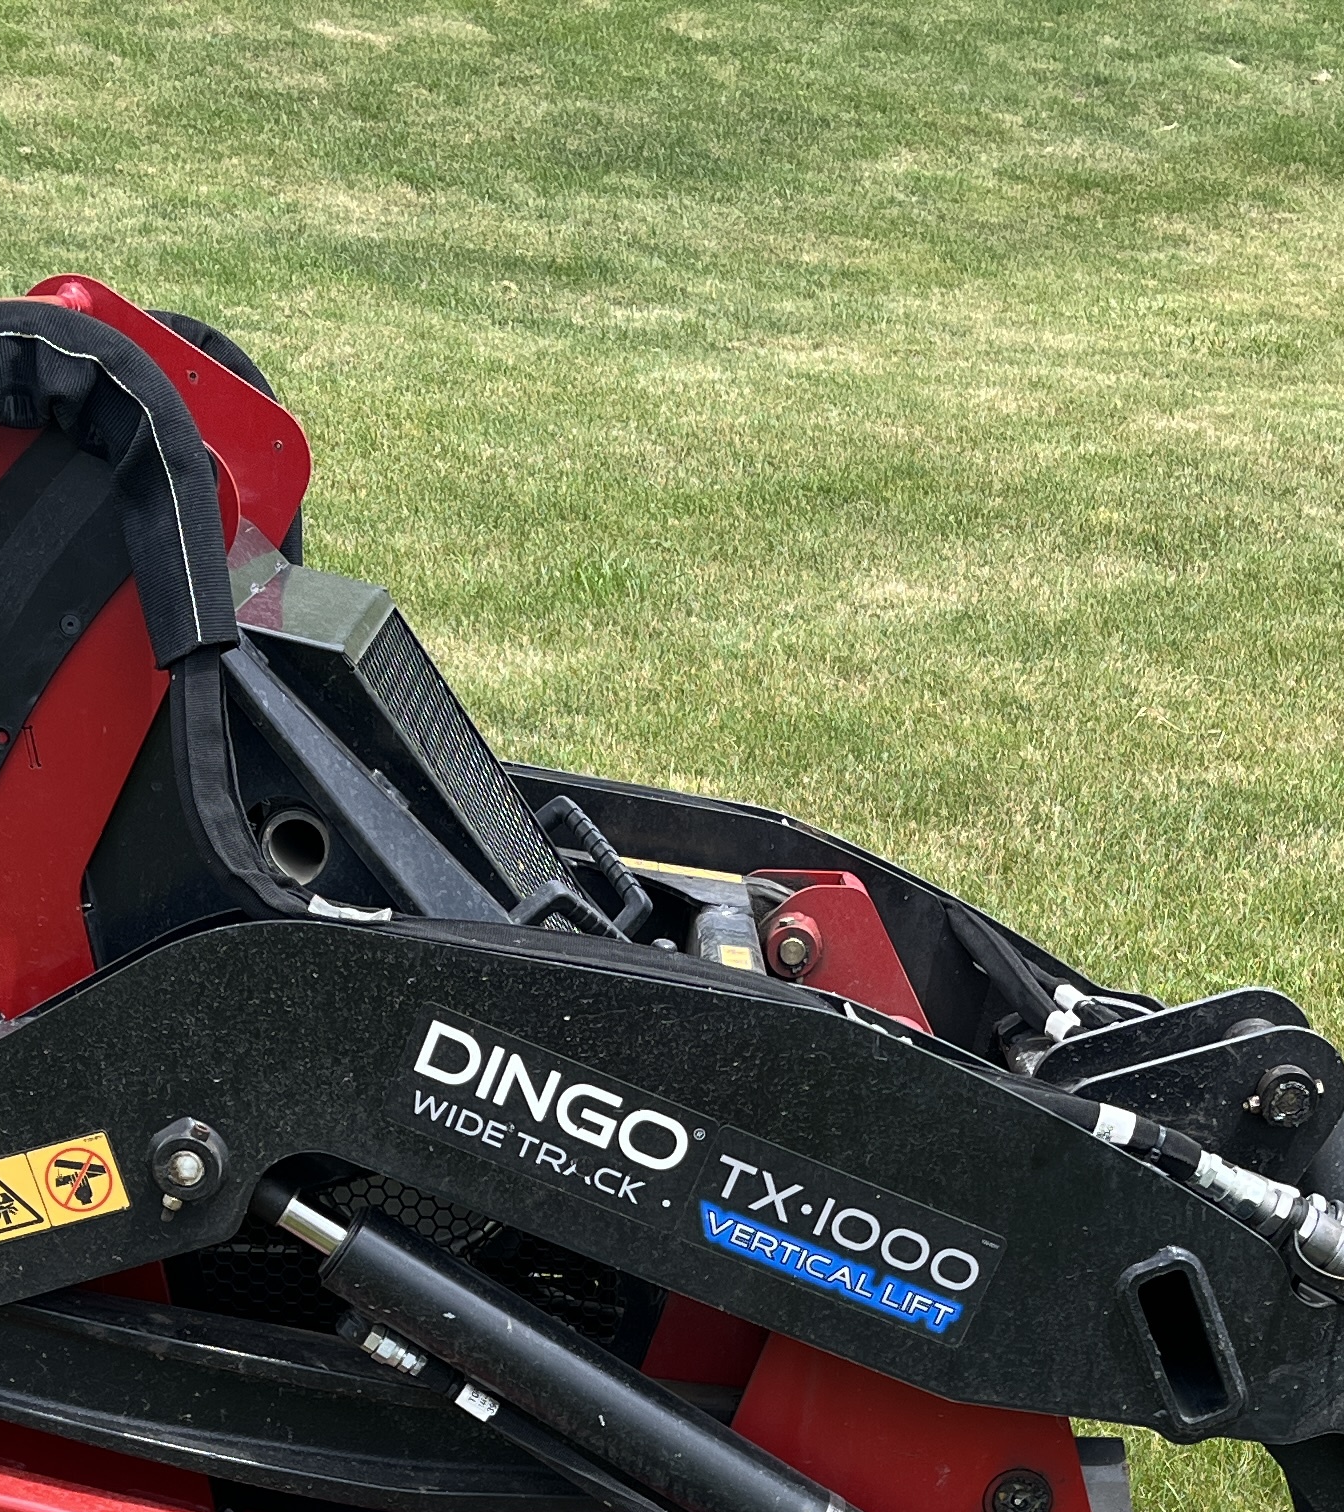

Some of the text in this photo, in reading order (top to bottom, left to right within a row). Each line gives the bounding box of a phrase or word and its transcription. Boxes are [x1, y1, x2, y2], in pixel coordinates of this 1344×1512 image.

[414, 1019, 689, 1170] DINGO
[414, 1089, 508, 1148] WIDE
[708, 1210, 956, 1326] VERTICAL LIFT
